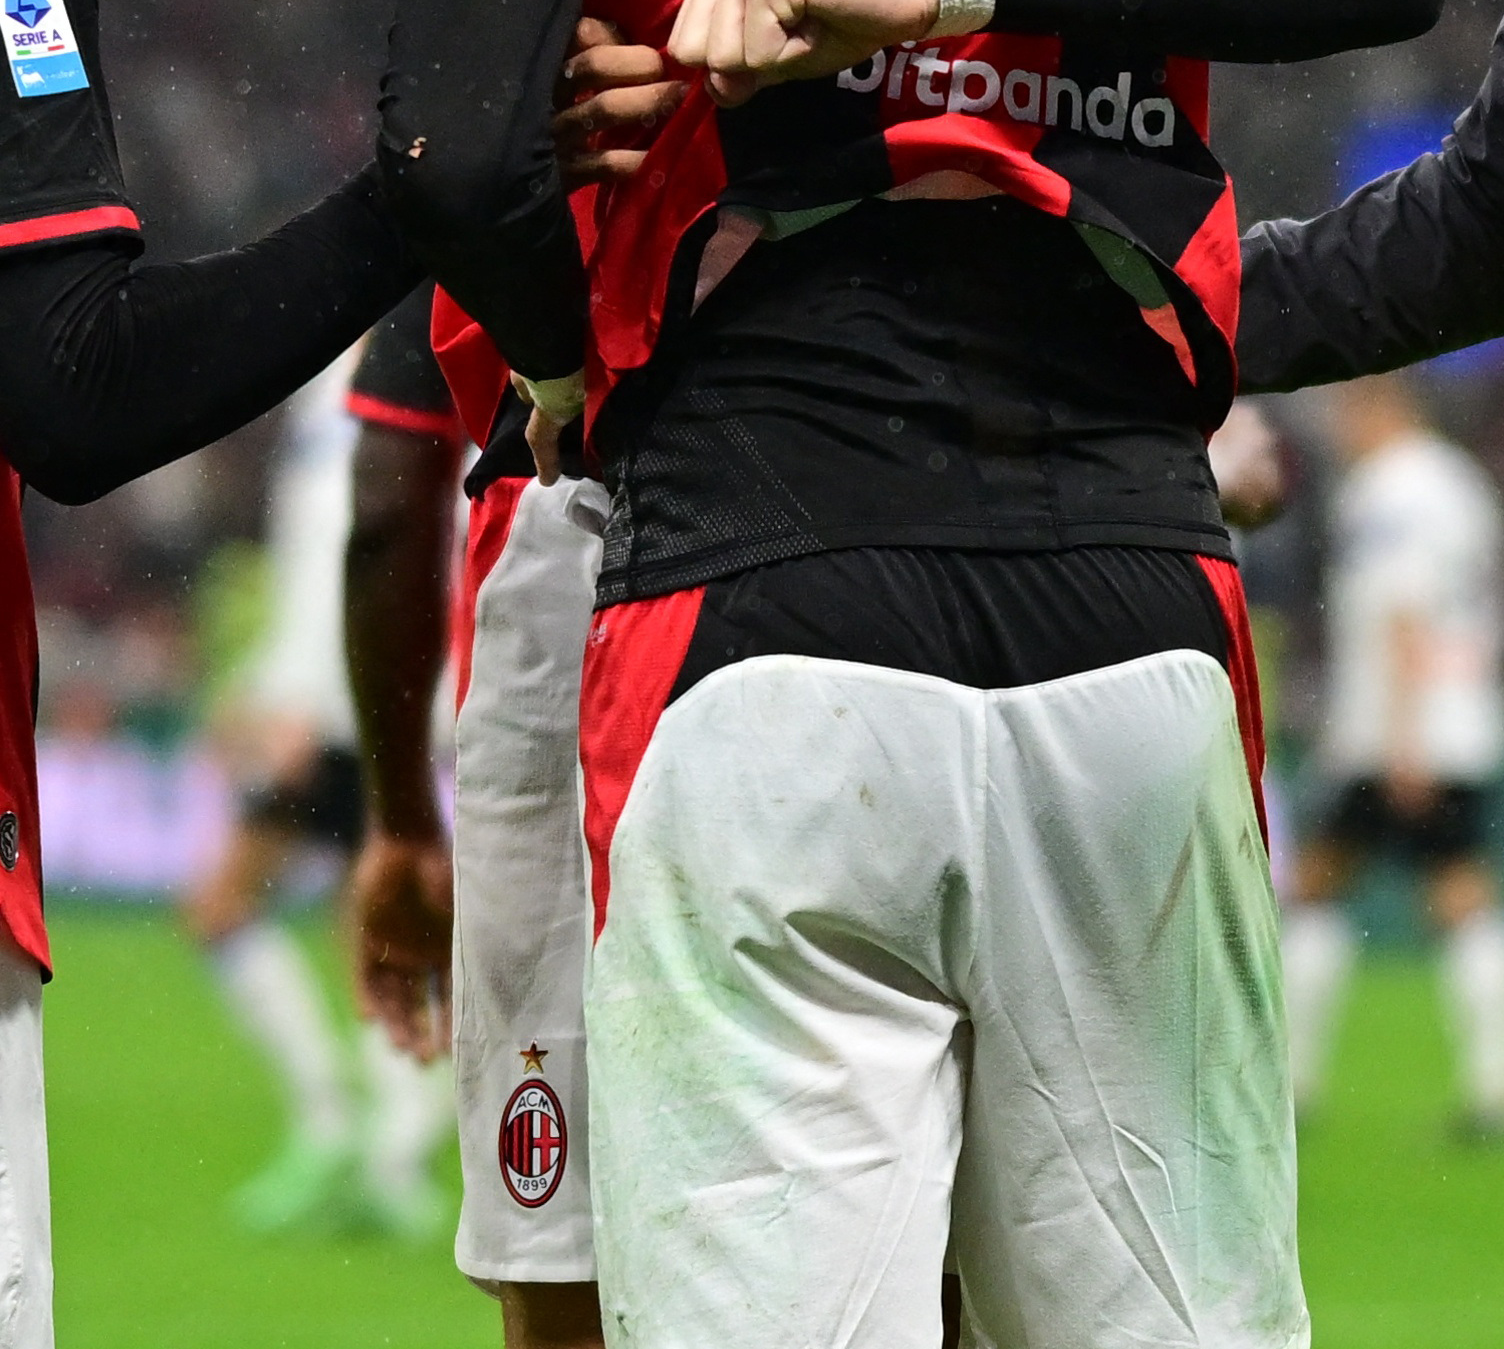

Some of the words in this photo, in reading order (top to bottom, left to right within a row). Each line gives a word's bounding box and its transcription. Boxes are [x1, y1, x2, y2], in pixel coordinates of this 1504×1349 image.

[12, 30, 49, 47] SERIE
[52, 29, 62, 42] A
[836, 40, 1176, 148] bitpanda
[515, 1091, 551, 1114] ACM
[516, 1177, 548, 1192] 1899
